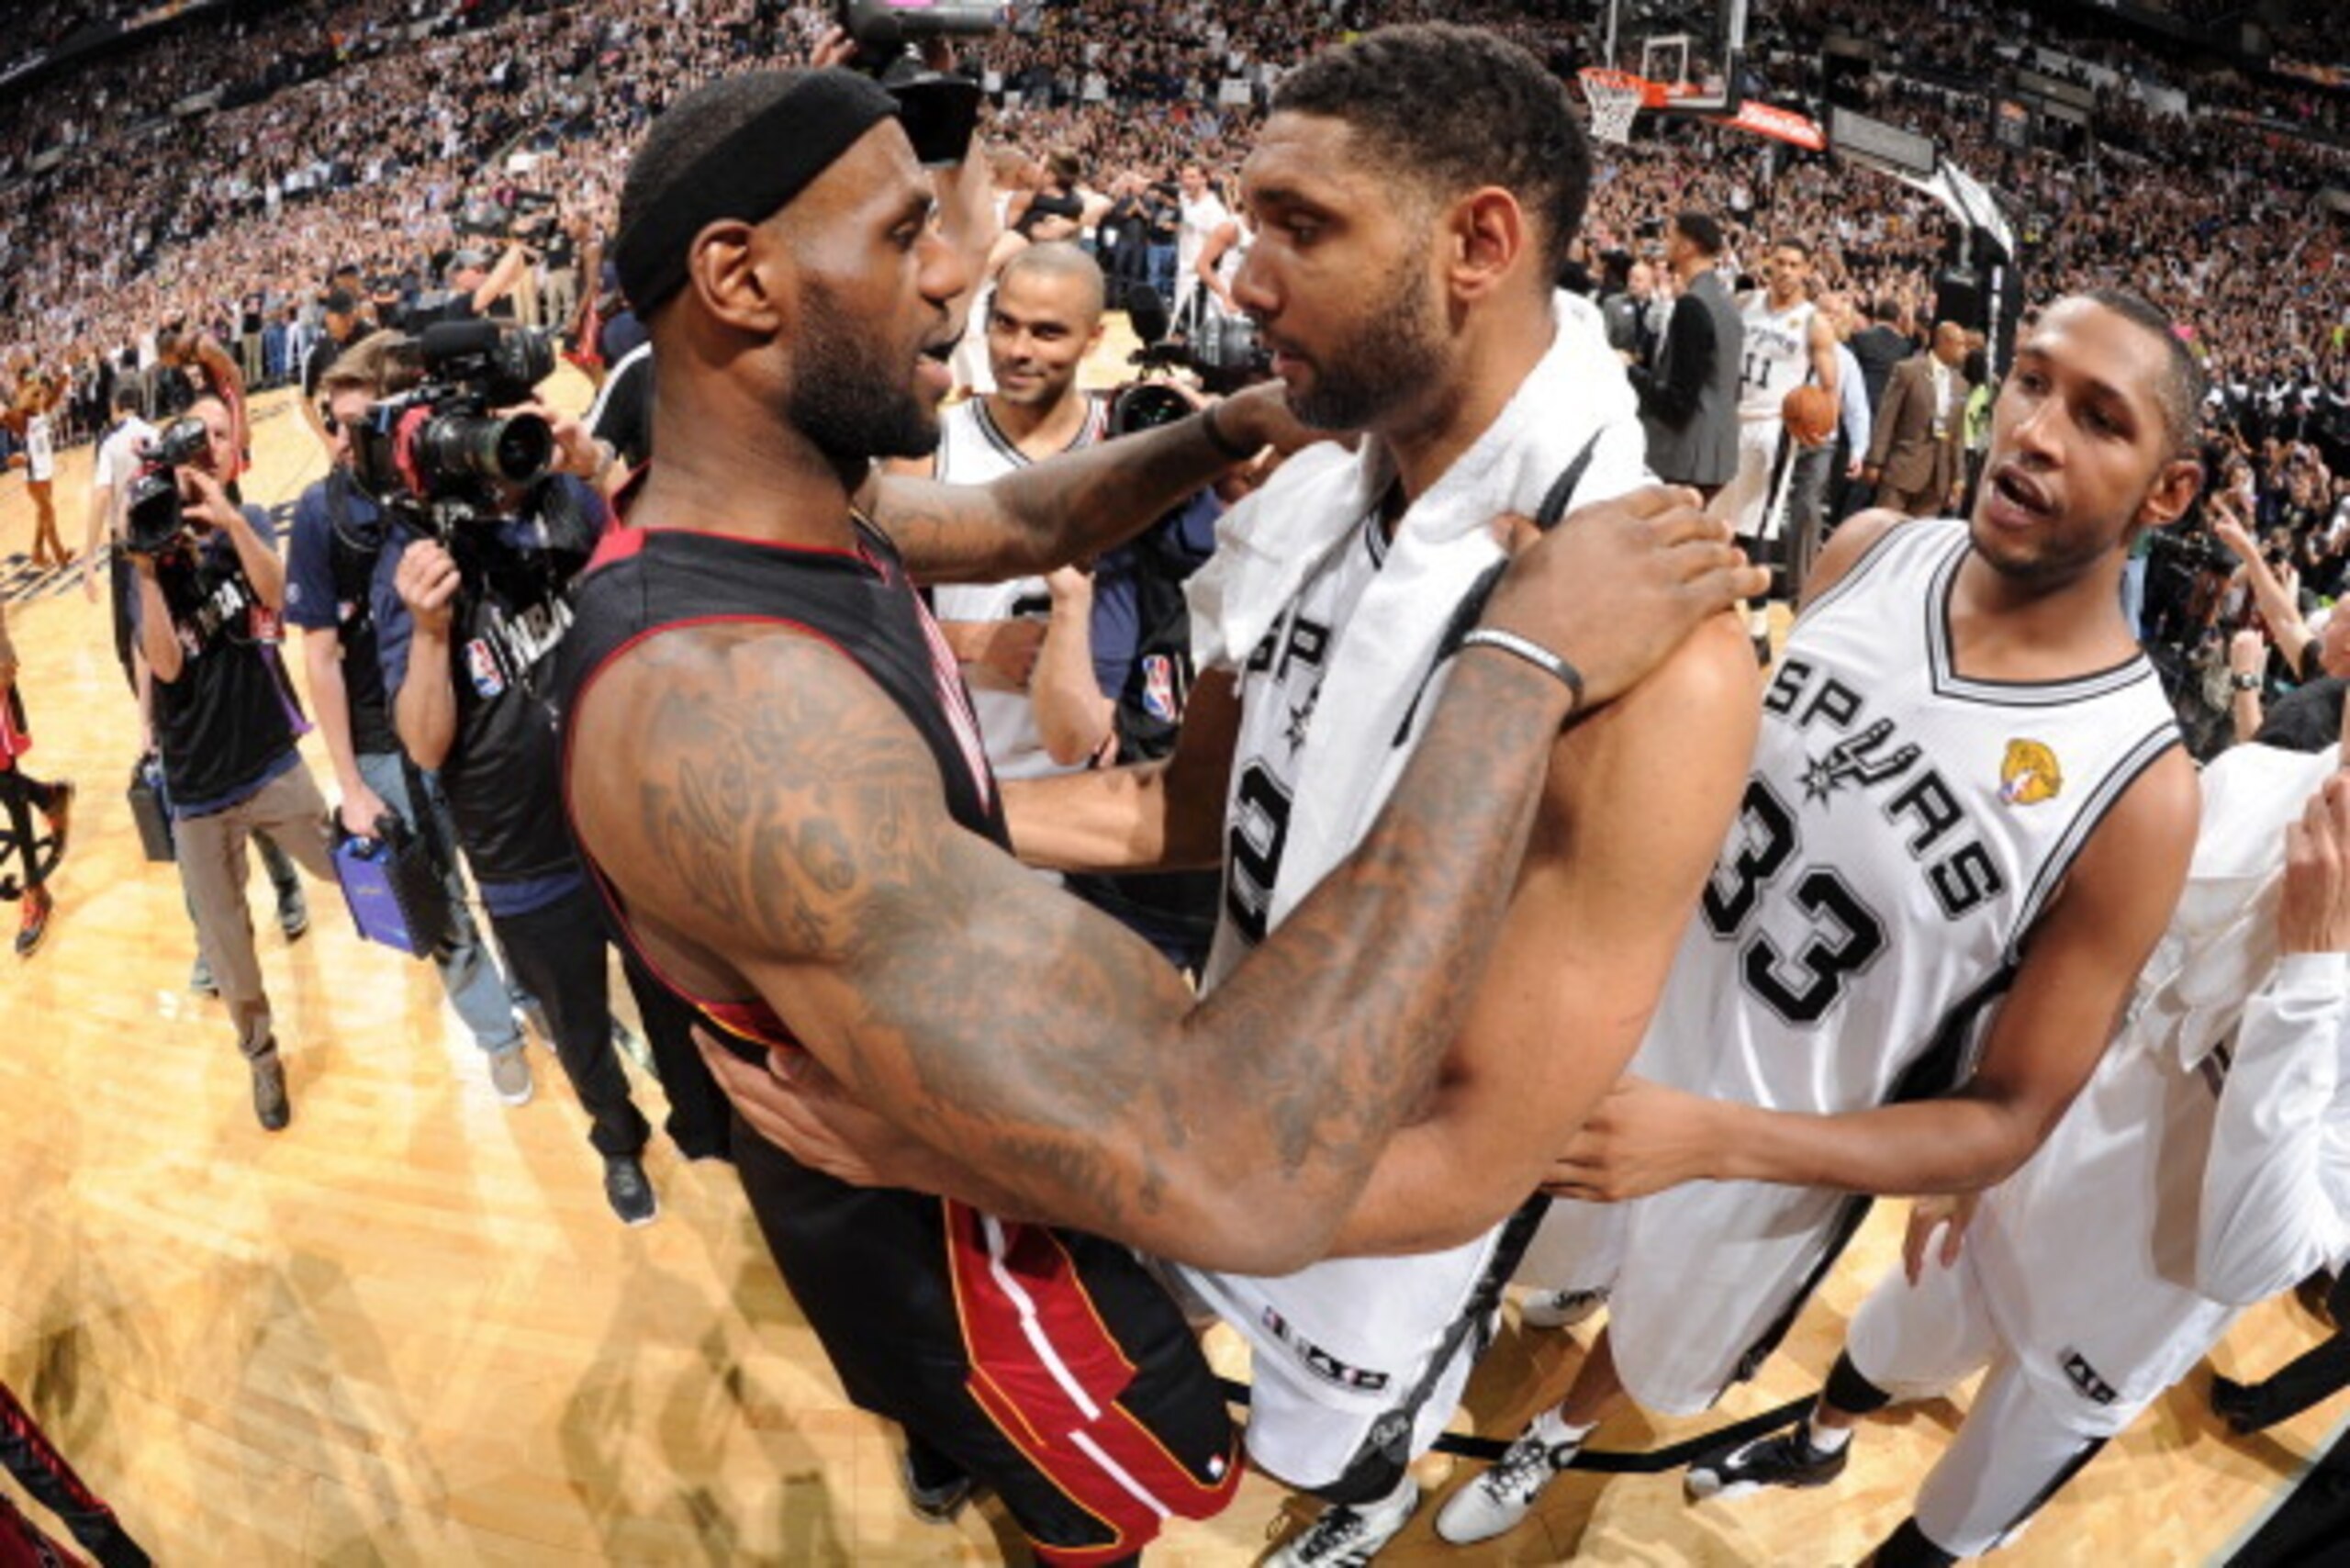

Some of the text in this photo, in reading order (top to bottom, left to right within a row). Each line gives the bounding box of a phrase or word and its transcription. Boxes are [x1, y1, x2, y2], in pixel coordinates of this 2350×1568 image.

[1739, 352, 1772, 389] 11
[1700, 770, 1889, 1026] 33
[1762, 658, 2007, 920] SPURS
